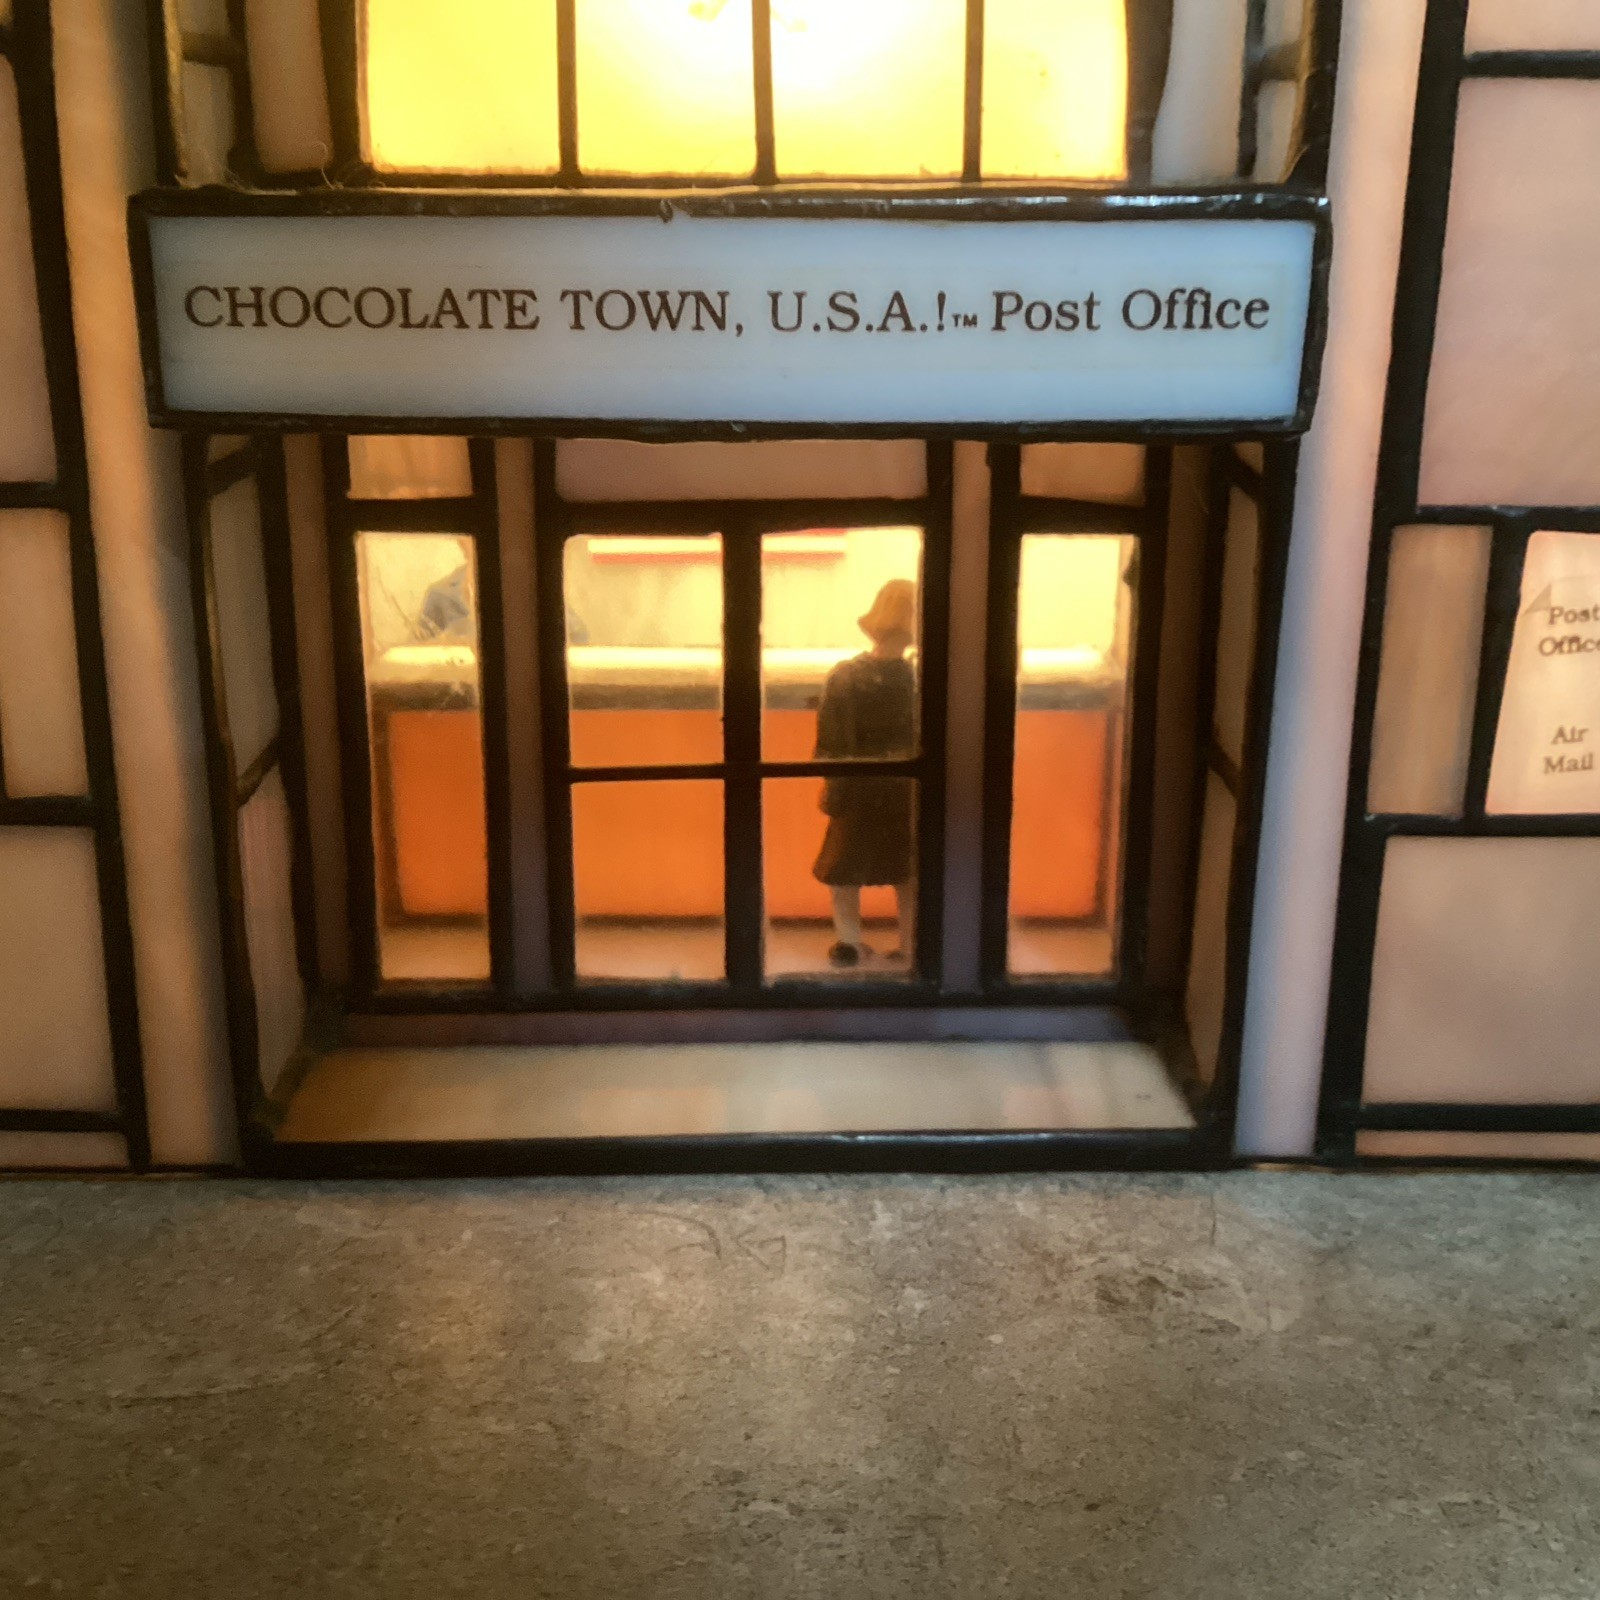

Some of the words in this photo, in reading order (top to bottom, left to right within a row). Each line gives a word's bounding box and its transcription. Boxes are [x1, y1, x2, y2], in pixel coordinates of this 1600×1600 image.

[184, 285, 538, 331] CHOCOLATE
[561, 289, 745, 337] TOWN,
[993, 289, 1101, 333] Post
[1122, 287, 1271, 331] Office
[1548, 604, 1600, 626] Post
[1552, 726, 1588, 745] Air
[1543, 753, 1594, 774] Mail
